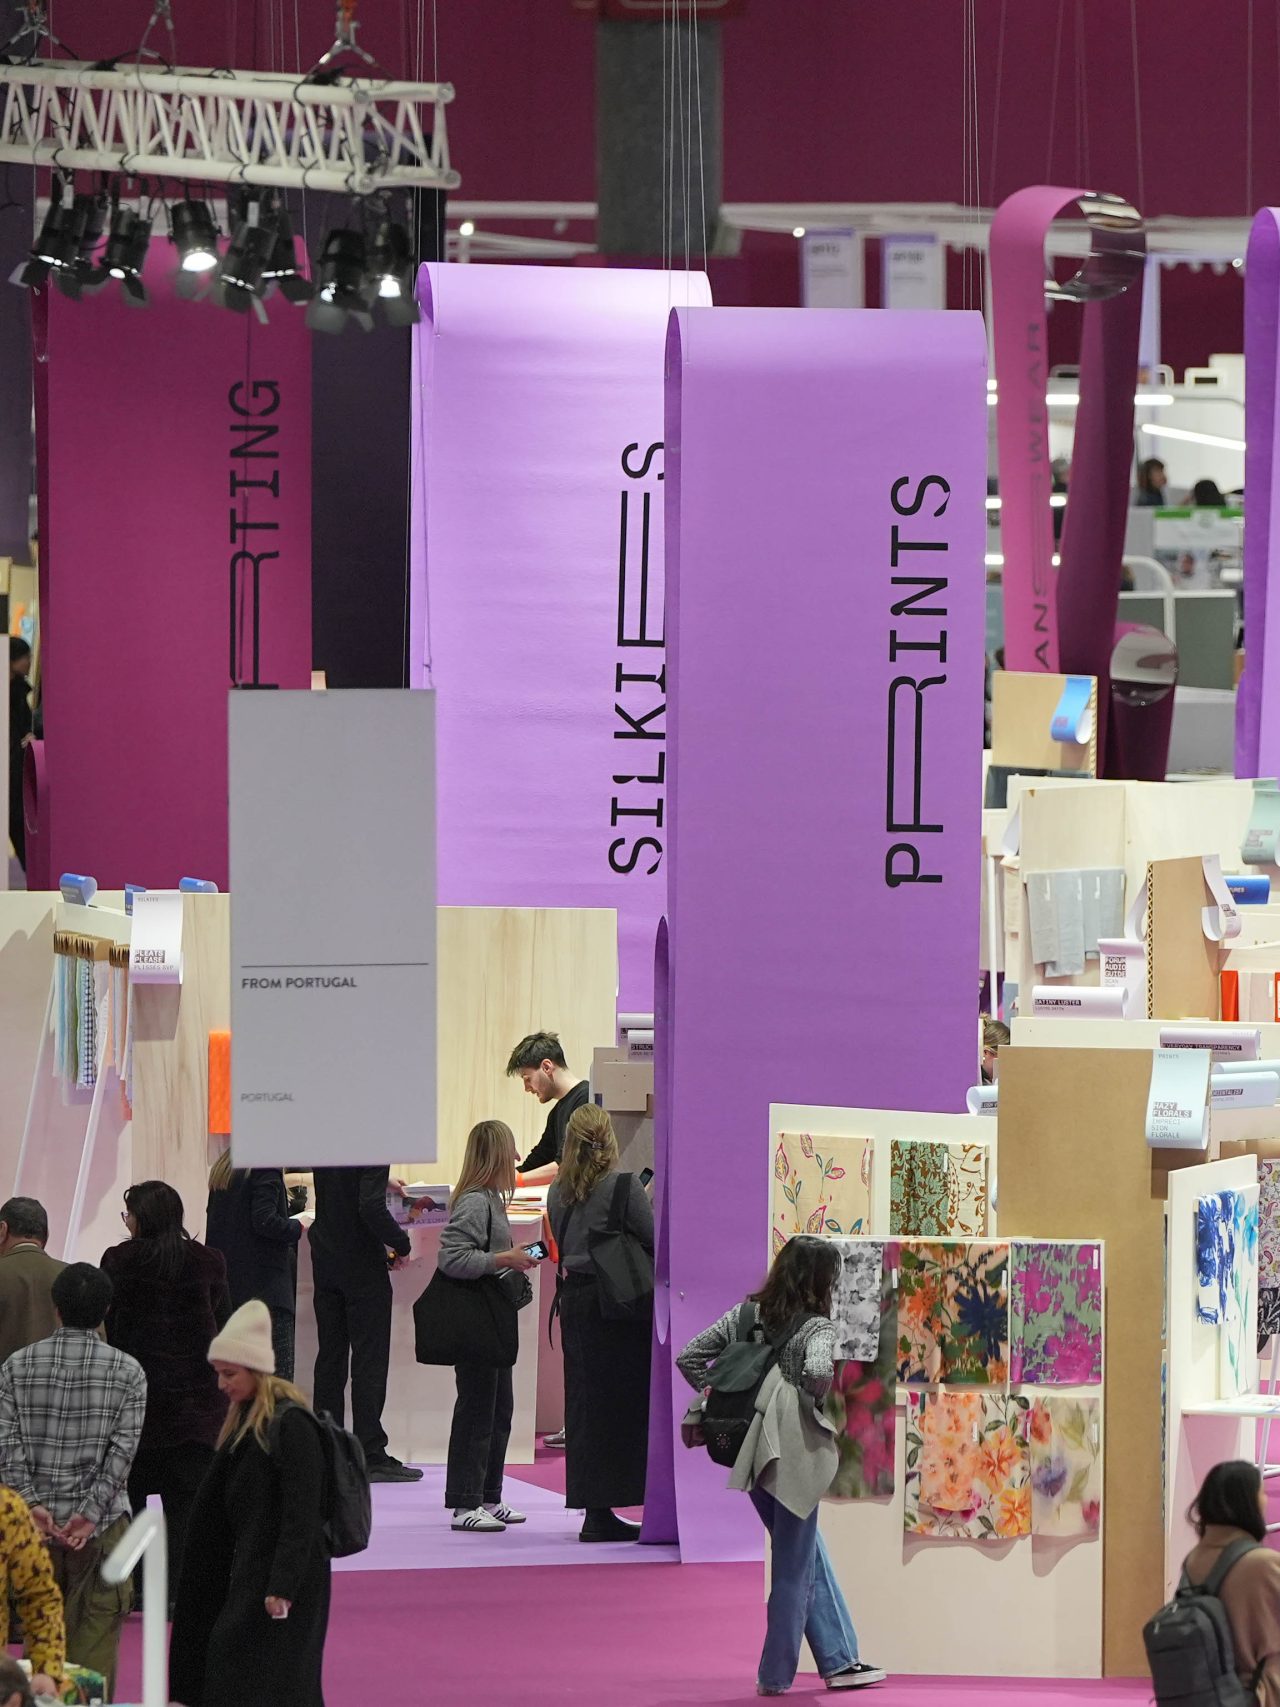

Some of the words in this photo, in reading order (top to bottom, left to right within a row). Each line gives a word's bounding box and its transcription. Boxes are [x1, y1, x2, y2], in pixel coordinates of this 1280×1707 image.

[608, 441, 667, 876] SILKIES
[885, 474, 951, 889] PRINTS
[134, 949, 164, 957] PLEATS
[134, 956, 164, 964] PLEASE
[242, 978, 282, 989] FROM
[285, 976, 358, 988] PORTUGAL
[241, 1093, 294, 1102] PORTUGAL
[1153, 1102, 1177, 1110] HAZY
[1153, 1110, 1191, 1118] FLORALS
